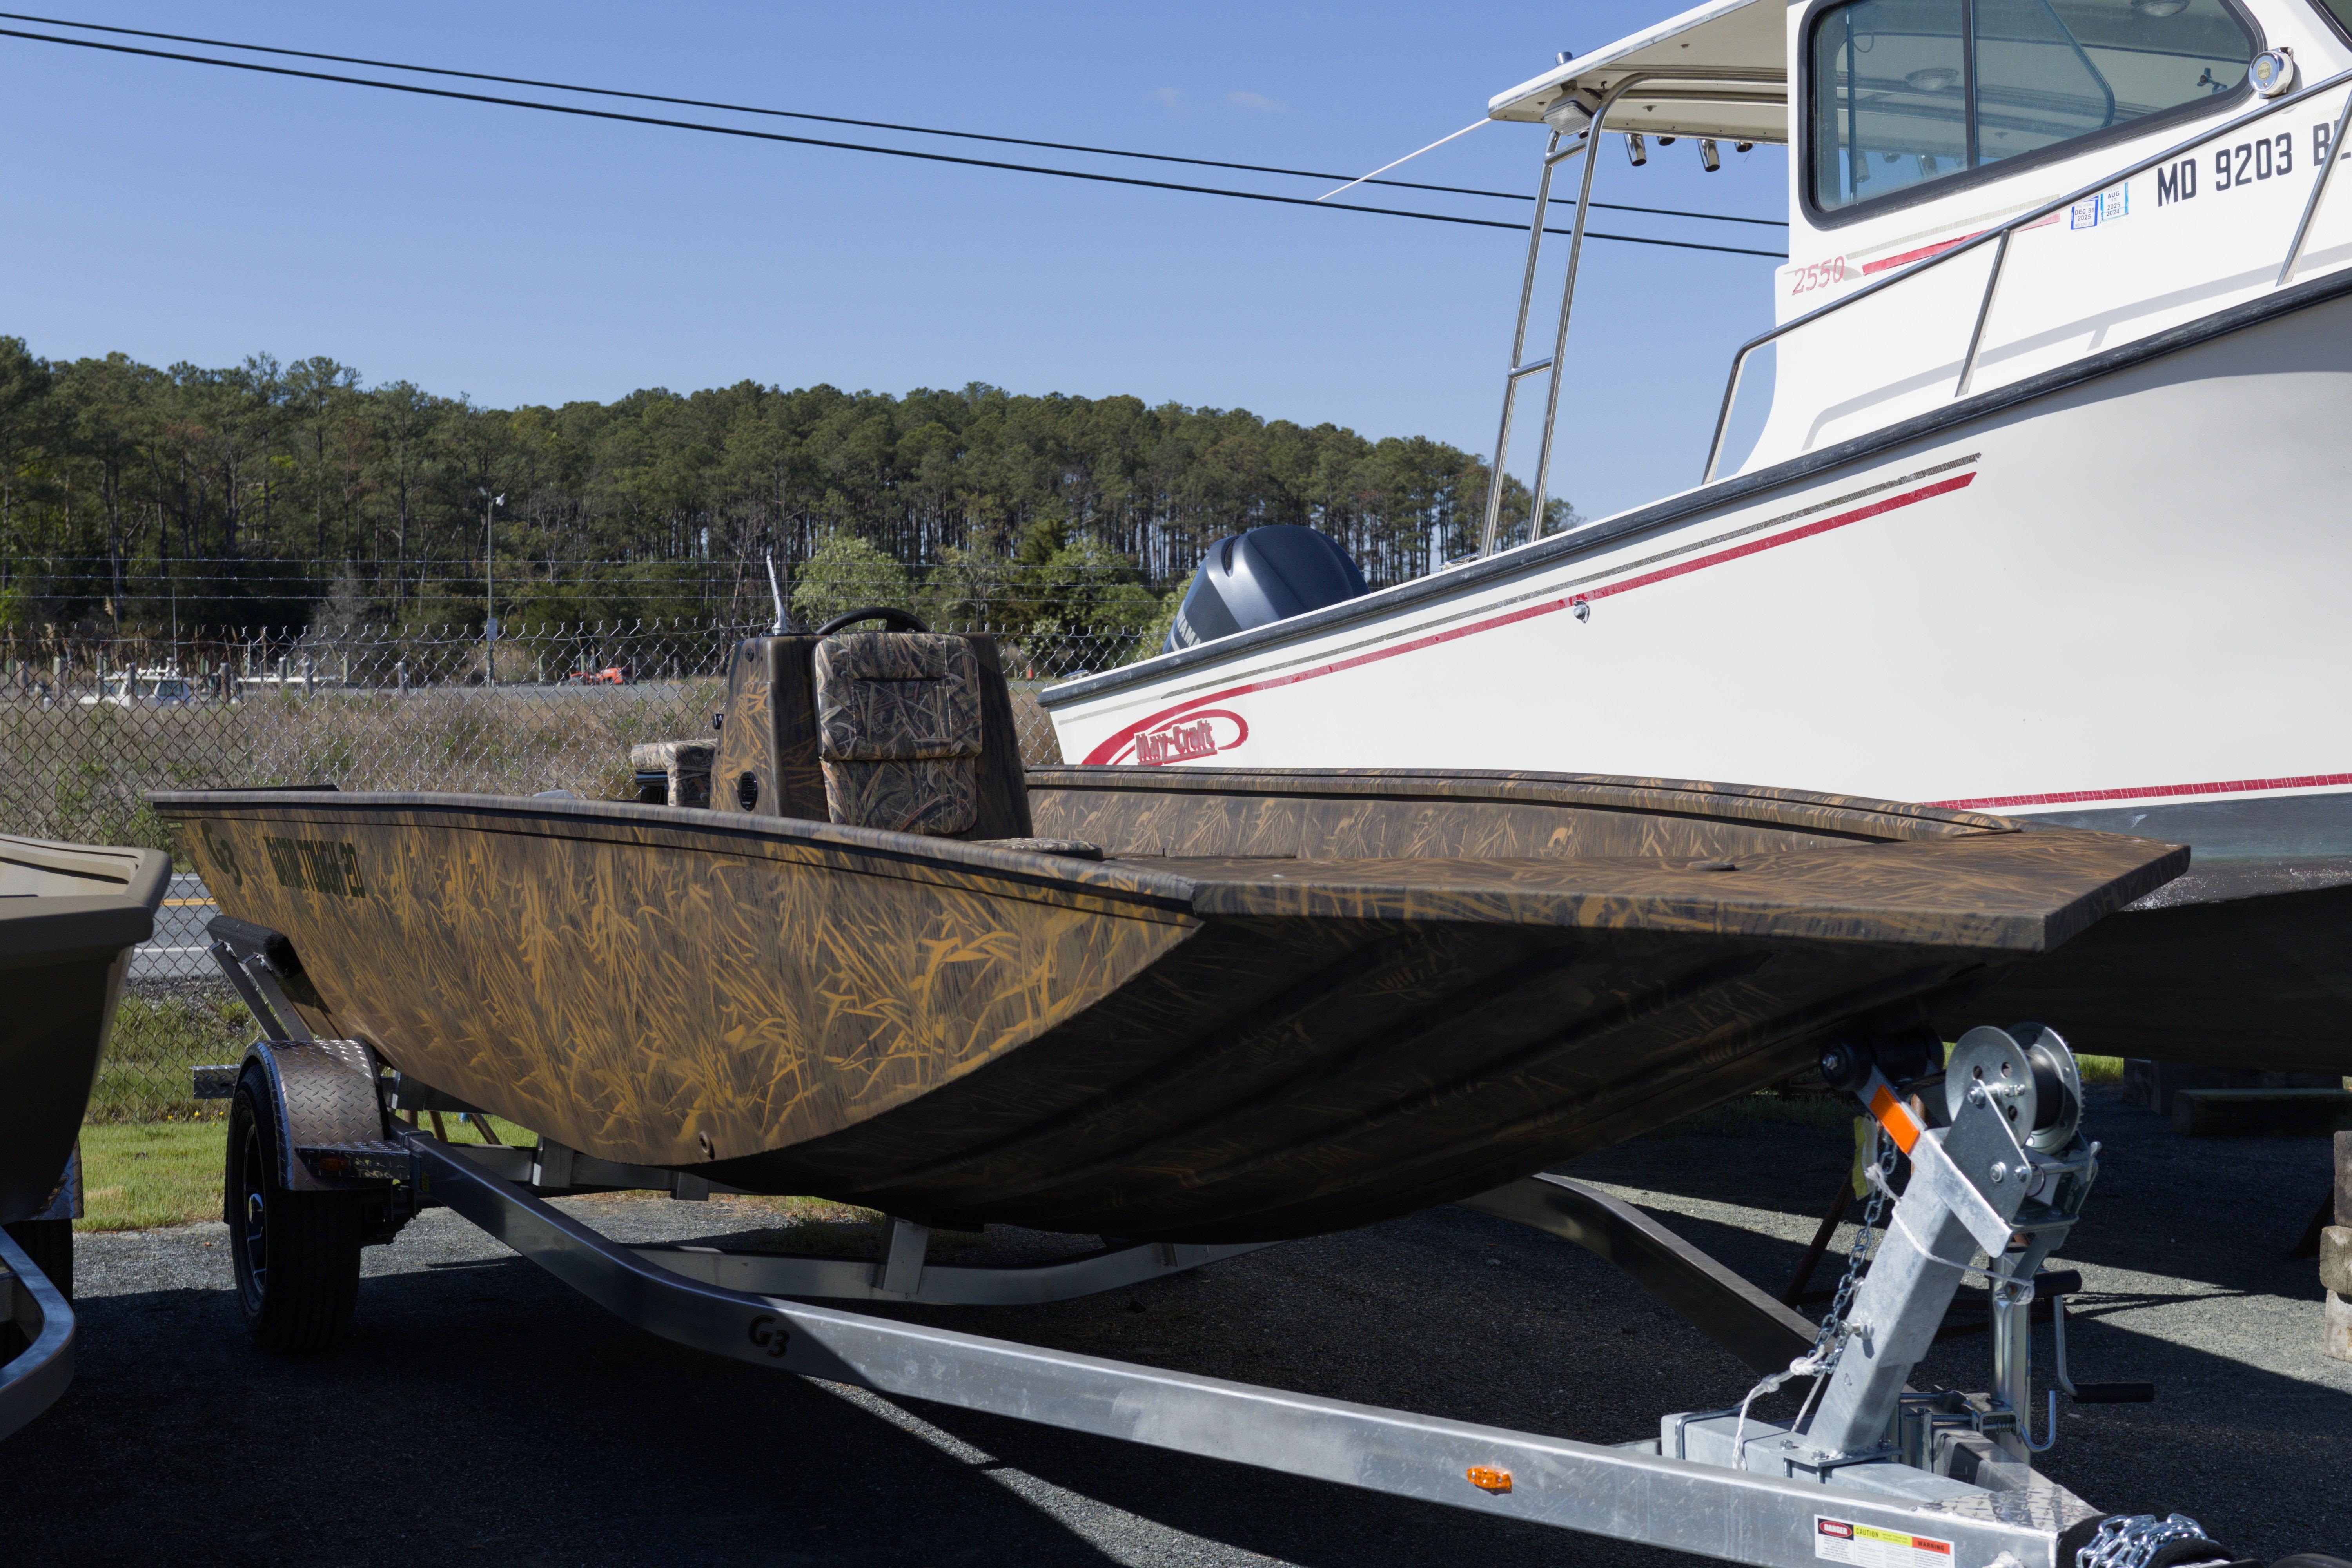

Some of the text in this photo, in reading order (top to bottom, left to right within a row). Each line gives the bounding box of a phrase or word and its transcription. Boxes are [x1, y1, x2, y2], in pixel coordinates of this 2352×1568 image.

[2158, 158, 2196, 207] MD
[2216, 132, 2292, 191] 9203
[1792, 256, 1844, 296] 2550
[1135, 720, 1217, 765] May-Craft
[201, 820, 243, 887] G3
[262, 836, 366, 898] GATOR TOUGH 20
[748, 1315, 790, 1358] G3
[1824, 1523, 1848, 1535] DANGER
[1856, 1528, 1879, 1538] CAUTION
[1918, 1540, 1945, 1551] WARNING
